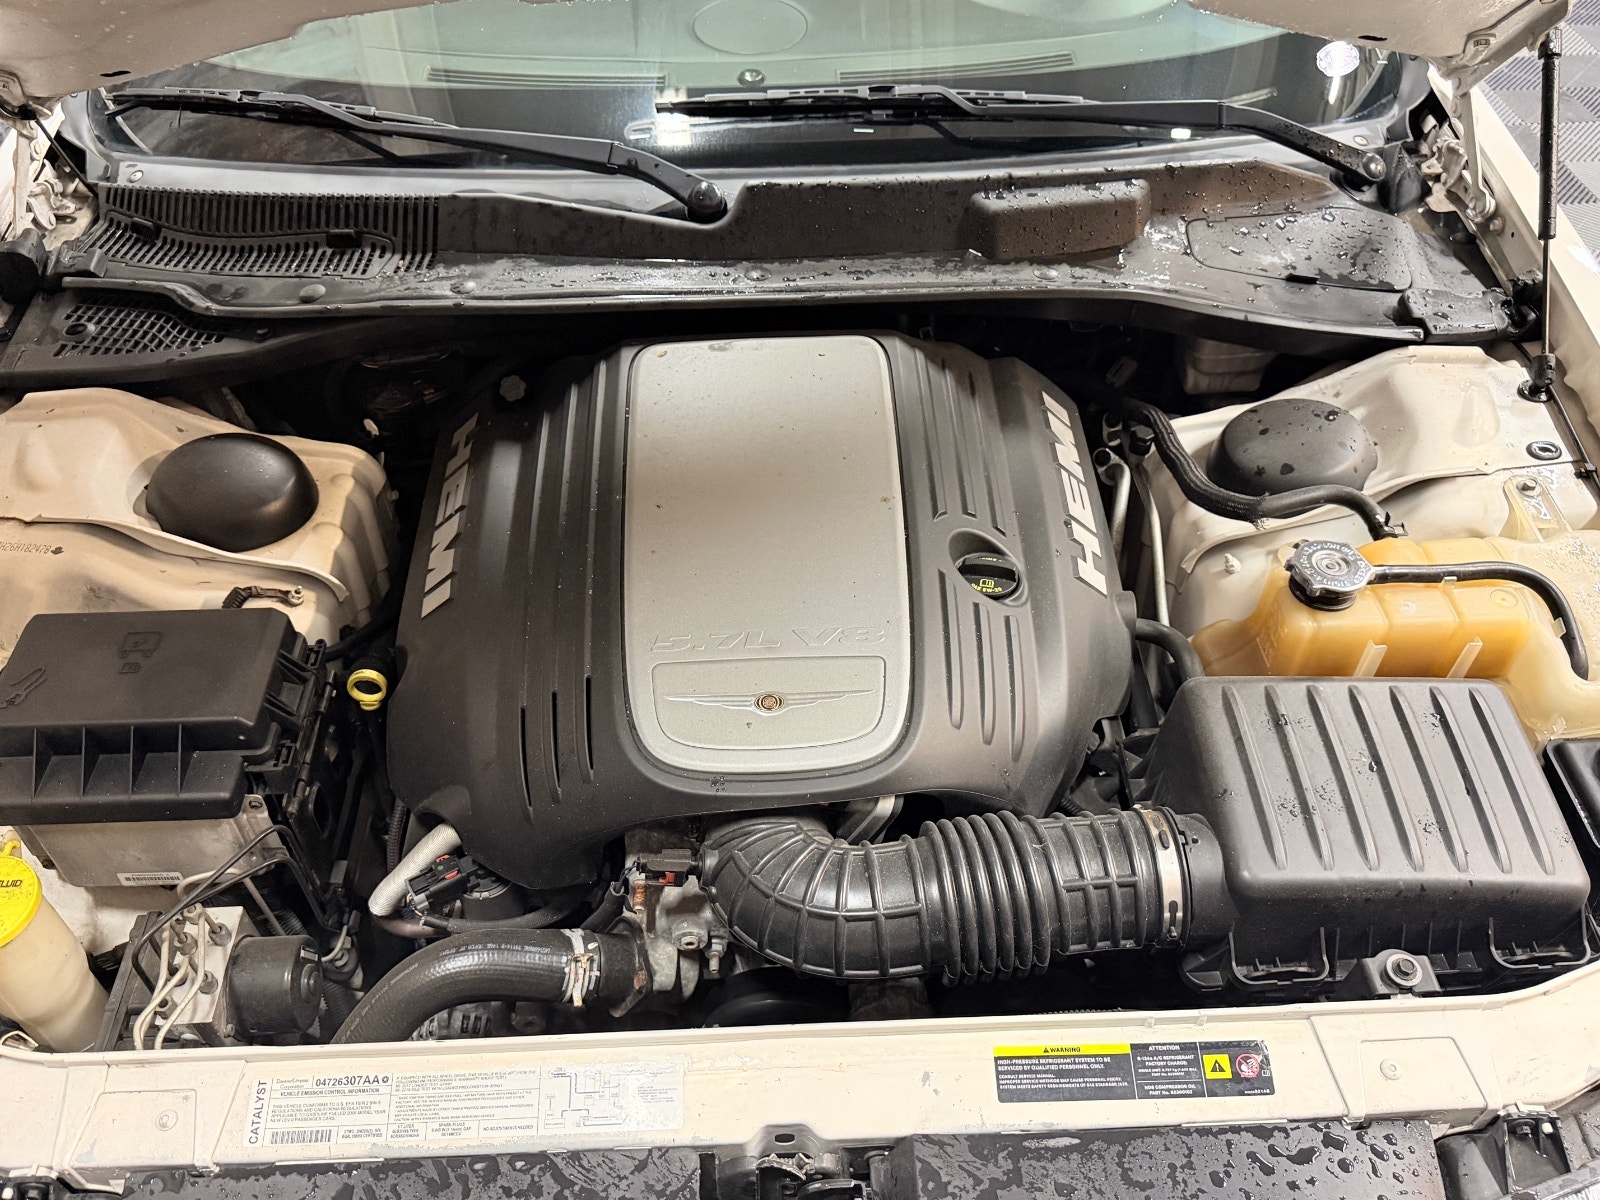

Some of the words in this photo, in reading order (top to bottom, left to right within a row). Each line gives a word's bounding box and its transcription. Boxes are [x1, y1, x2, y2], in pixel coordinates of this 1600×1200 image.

[421, 412, 478, 619] HEMI
[1042, 391, 1108, 596] HEMI
[651, 631, 781, 651] 5.7L
[792, 626, 885, 646] V8
[249, 1080, 267, 1144] CATALYST
[316, 1075, 380, 1087] 04726307AA
